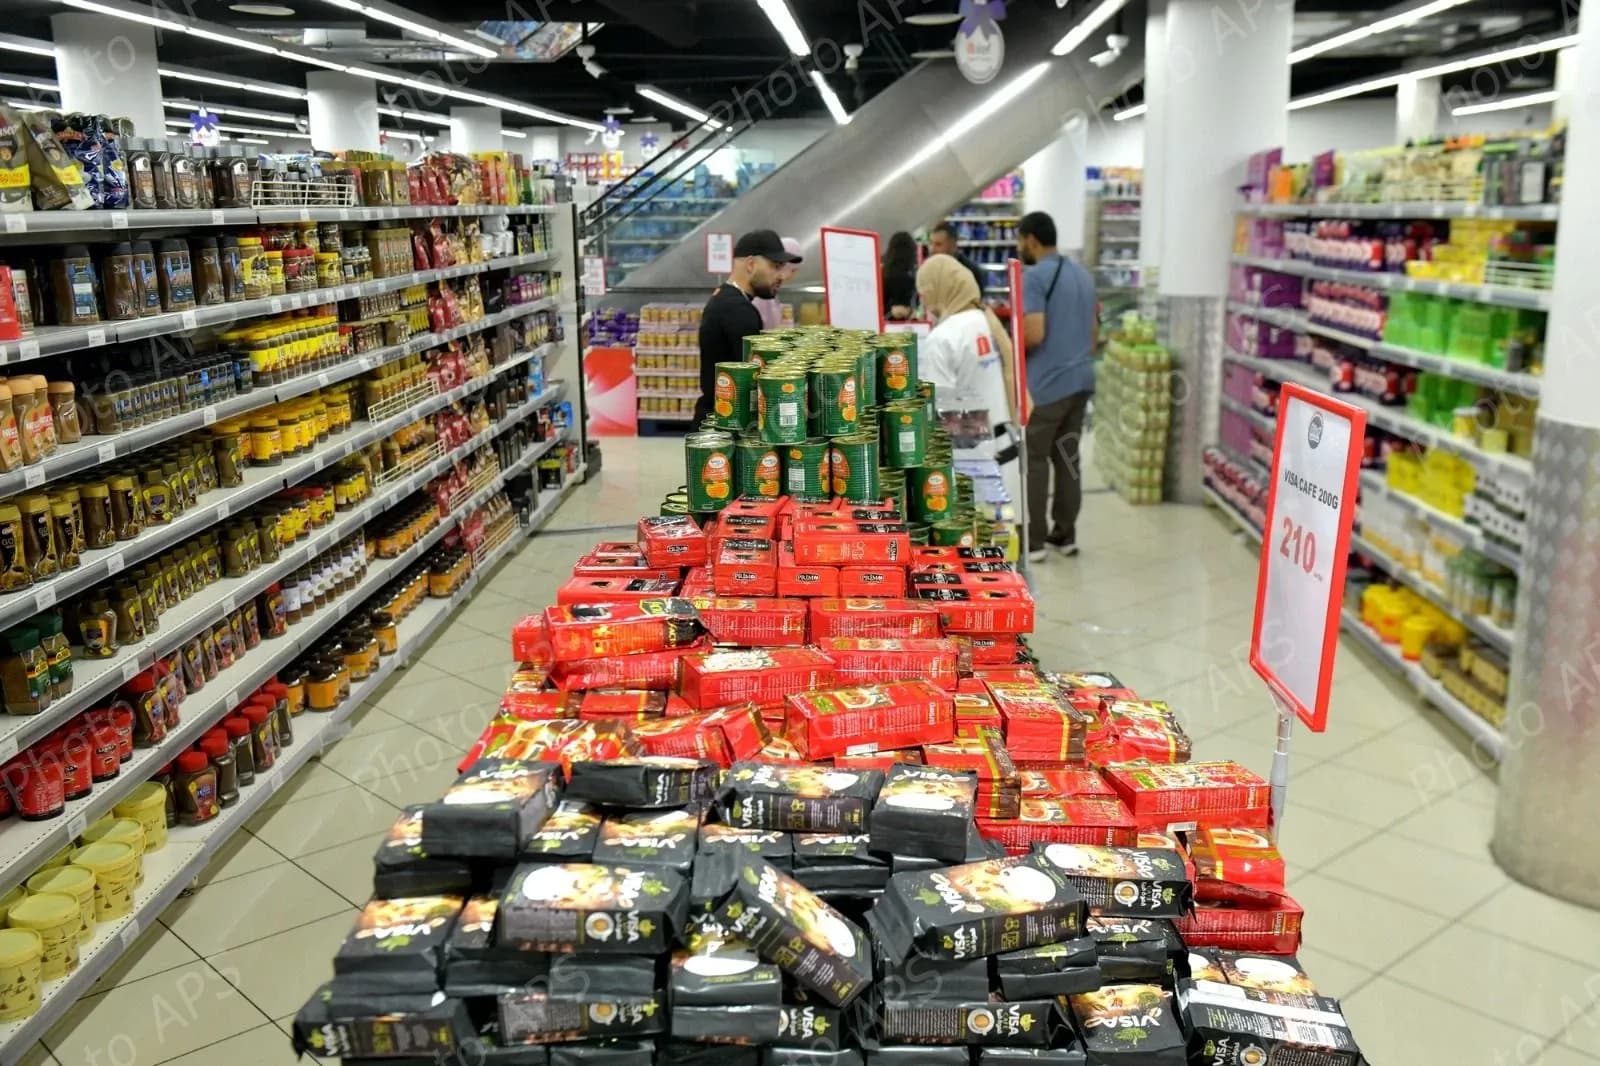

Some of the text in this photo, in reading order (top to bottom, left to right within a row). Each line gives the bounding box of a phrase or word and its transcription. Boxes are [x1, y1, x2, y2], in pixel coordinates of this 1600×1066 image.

[1284, 470, 1338, 509] VISA CAFE 200G
[1280, 516, 1316, 574] 210
[904, 769, 954, 780] VISA
[742, 796, 754, 827] VISA
[1151, 880, 1162, 912] VISA
[952, 925, 965, 960] VISA
[802, 1006, 815, 1038] VISA
[1007, 1004, 1020, 1038] VISA
[1213, 1036, 1231, 1066] VISA
